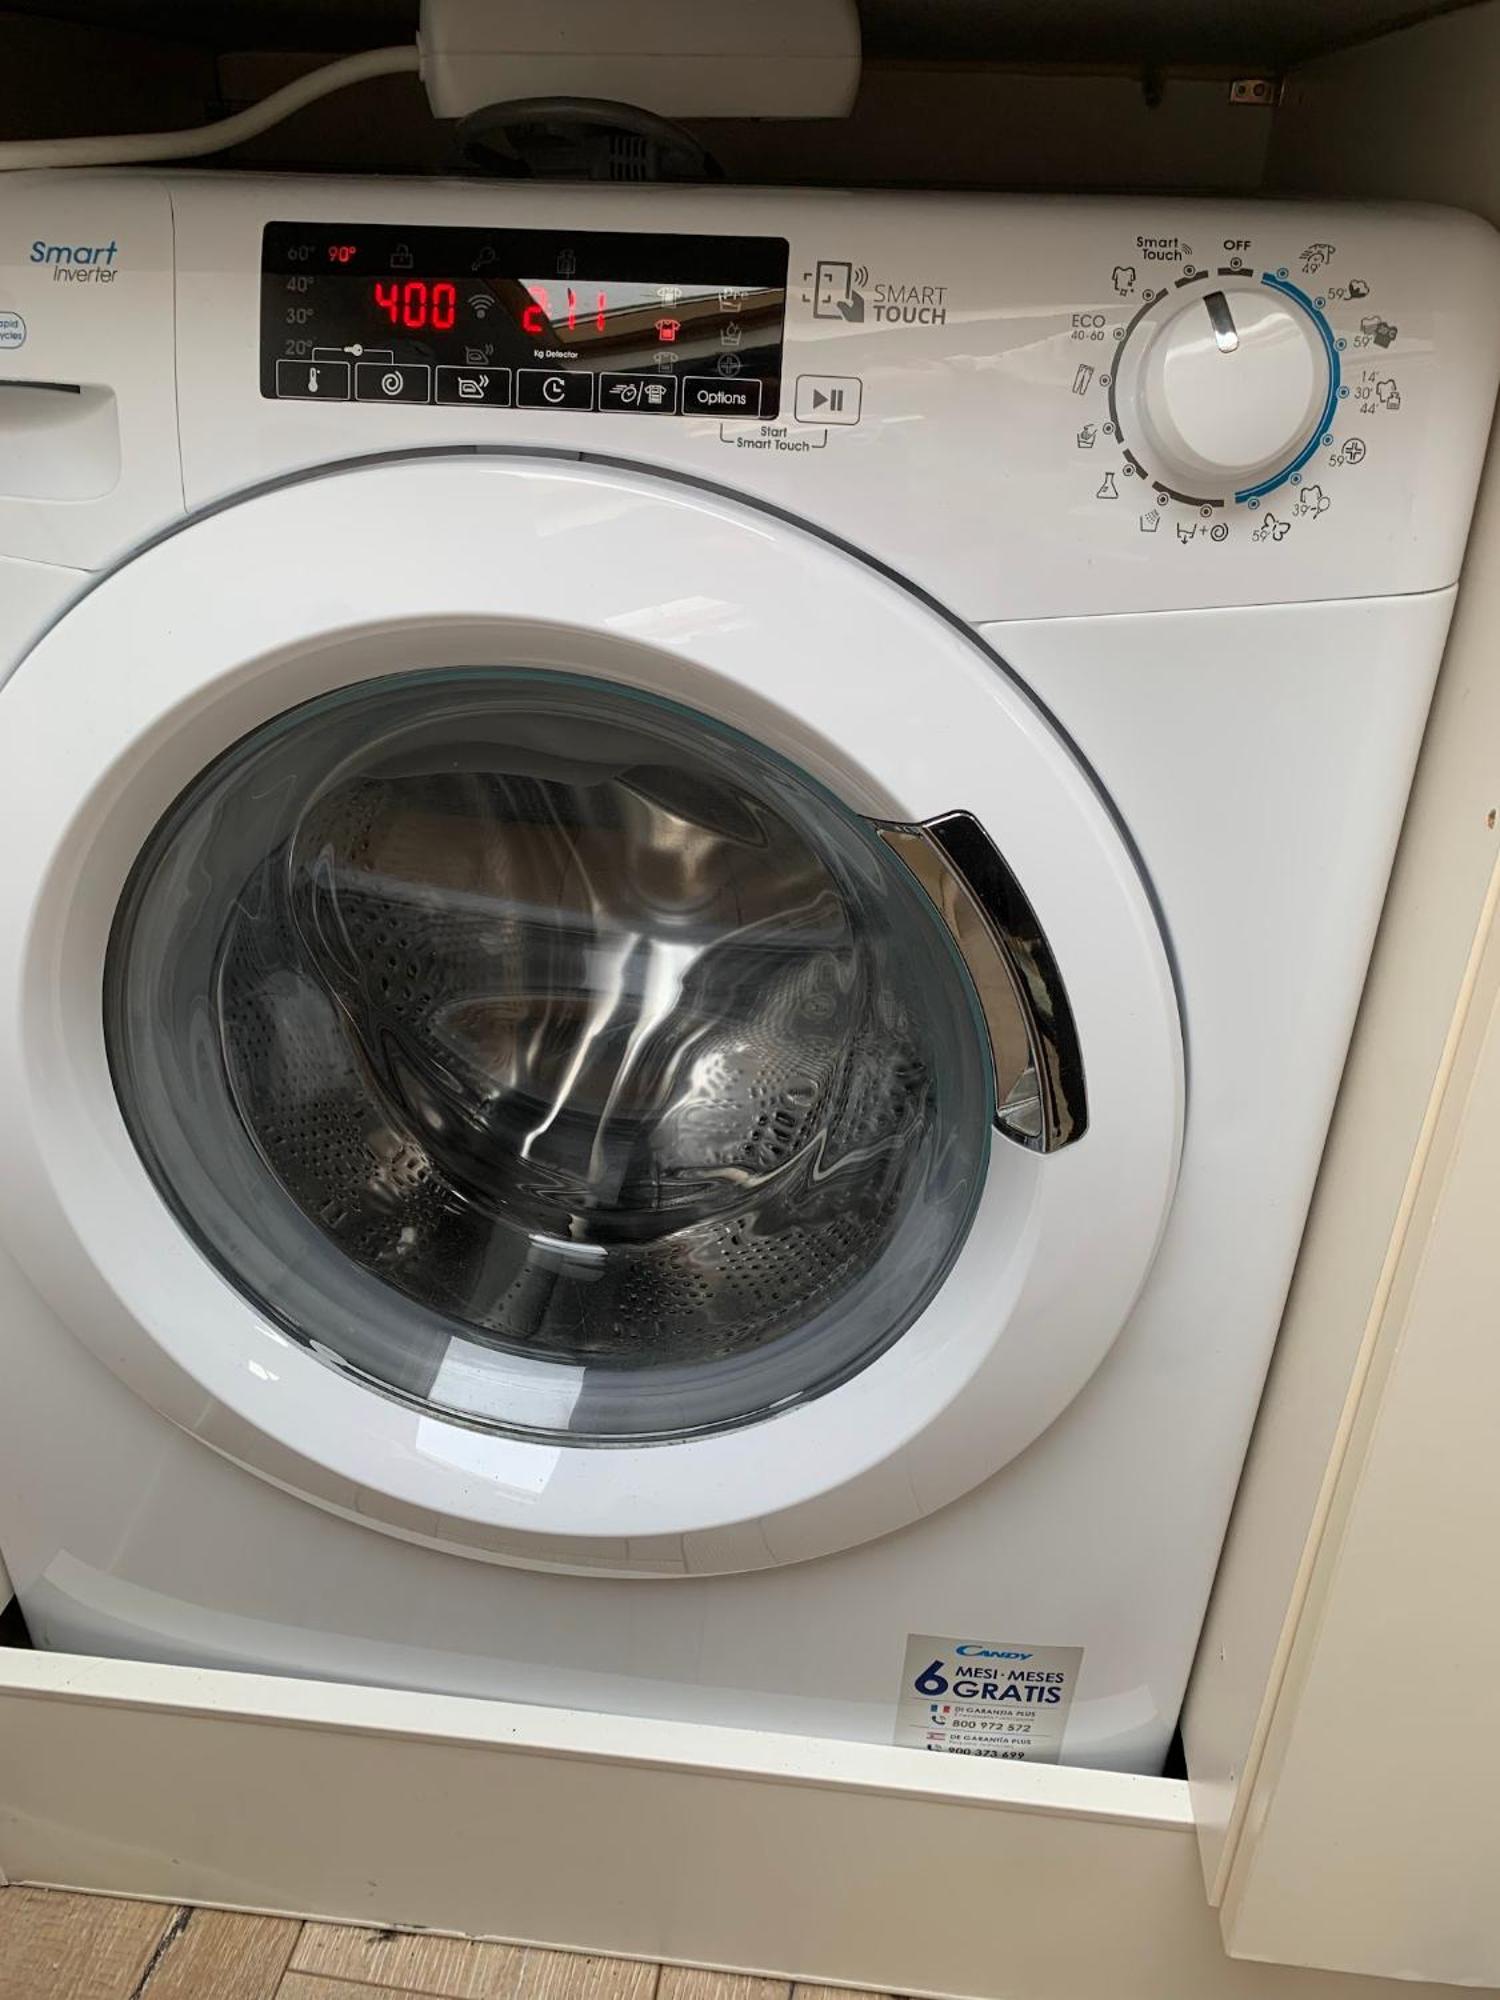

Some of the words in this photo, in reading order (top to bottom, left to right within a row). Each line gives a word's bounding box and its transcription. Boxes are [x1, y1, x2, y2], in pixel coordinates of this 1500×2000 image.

[1136, 236, 1179, 249] Smart
[1223, 240, 1251, 251] OFF
[30, 240, 118, 265] Smart
[1142, 249, 1182, 261] Touch
[53, 265, 118, 283] Inverter
[873, 284, 948, 305] SMART
[374, 281, 456, 329] 400
[873, 305, 946, 325] TOUCH
[1071, 314, 1106, 328] ECO
[0, 319, 18, 329] apid
[534, 349, 545, 359] Kg
[697, 389, 747, 406] Options
[760, 426, 788, 438] Start
[736, 437, 771, 449] Smart
[775, 439, 810, 452] Touch
[914, 1659, 949, 1696] 6
[955, 1666, 998, 1680] MESI
[1008, 1671, 1064, 1683] MESES
[952, 1680, 1062, 1704] GRATIS
[952, 1719, 977, 1730] 800
[1007, 1724, 1032, 1734] 572
